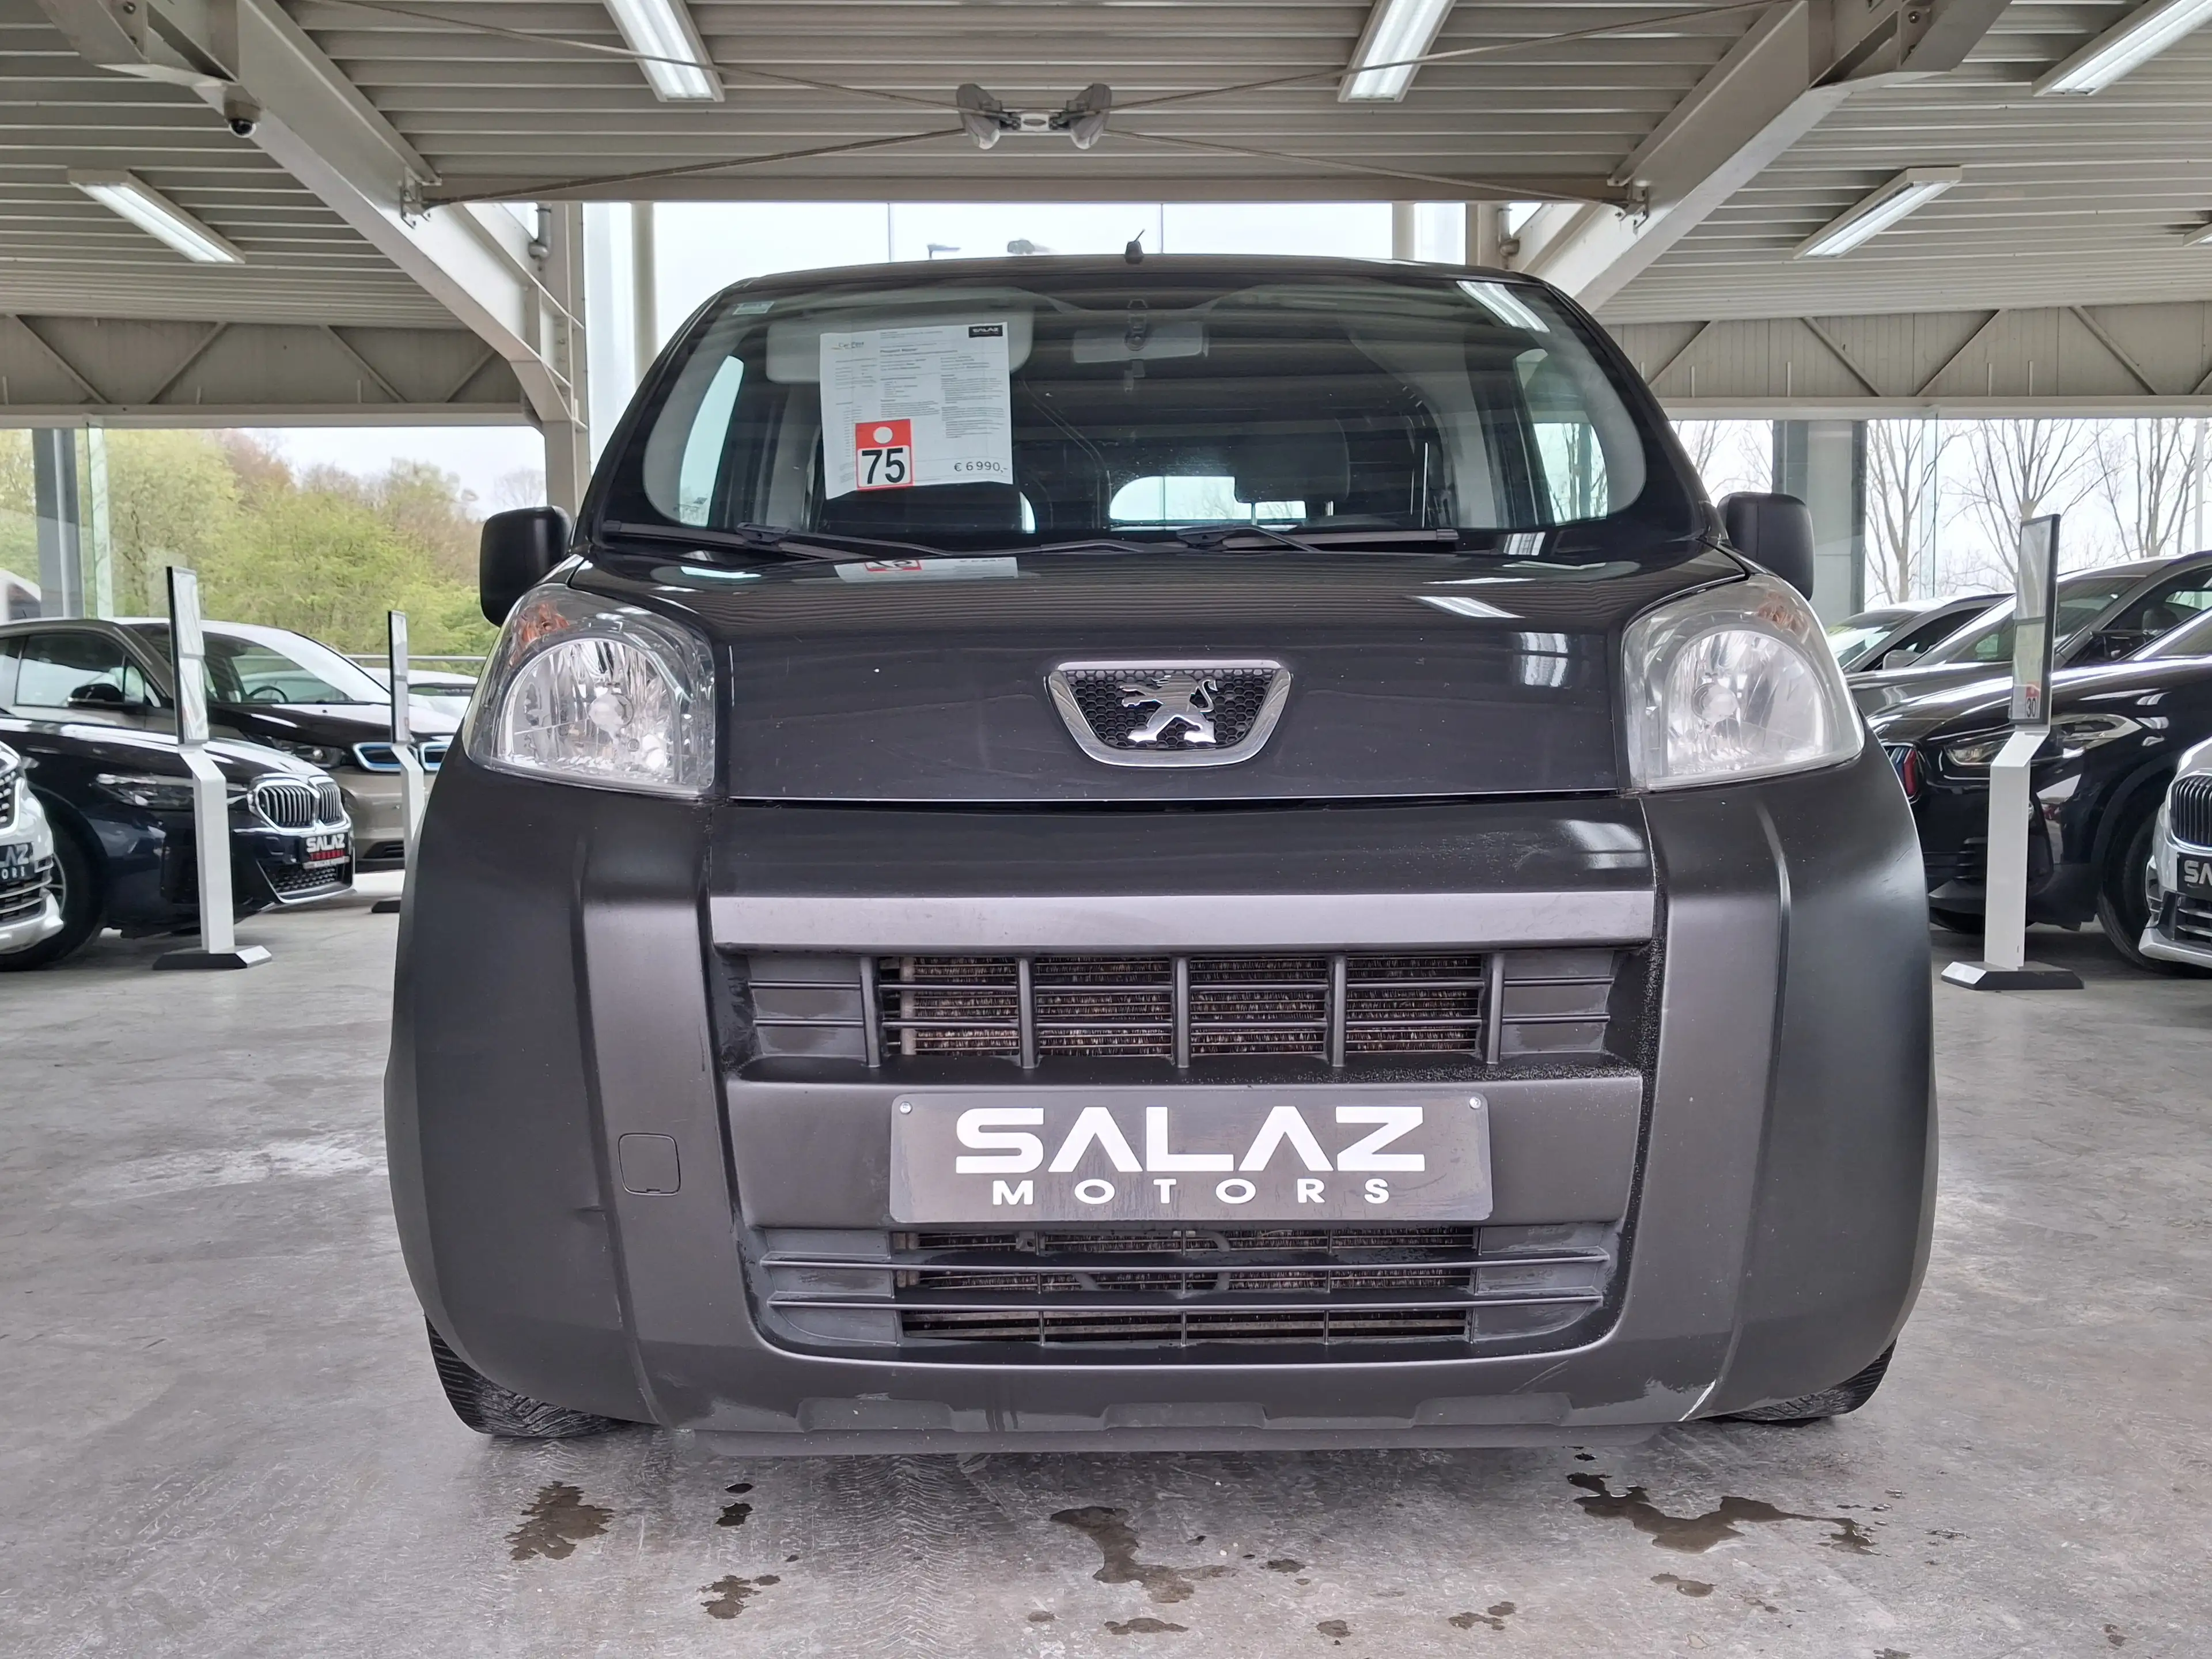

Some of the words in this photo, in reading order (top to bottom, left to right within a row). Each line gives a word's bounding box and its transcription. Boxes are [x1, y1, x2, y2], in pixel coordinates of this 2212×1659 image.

[862, 448, 905, 484] 75
[2027, 698, 2036, 718] 30
[306, 833, 345, 853] SALAZ
[956, 1106, 1425, 1174] SALAZ
[993, 1179, 1389, 1205] MOTORS
